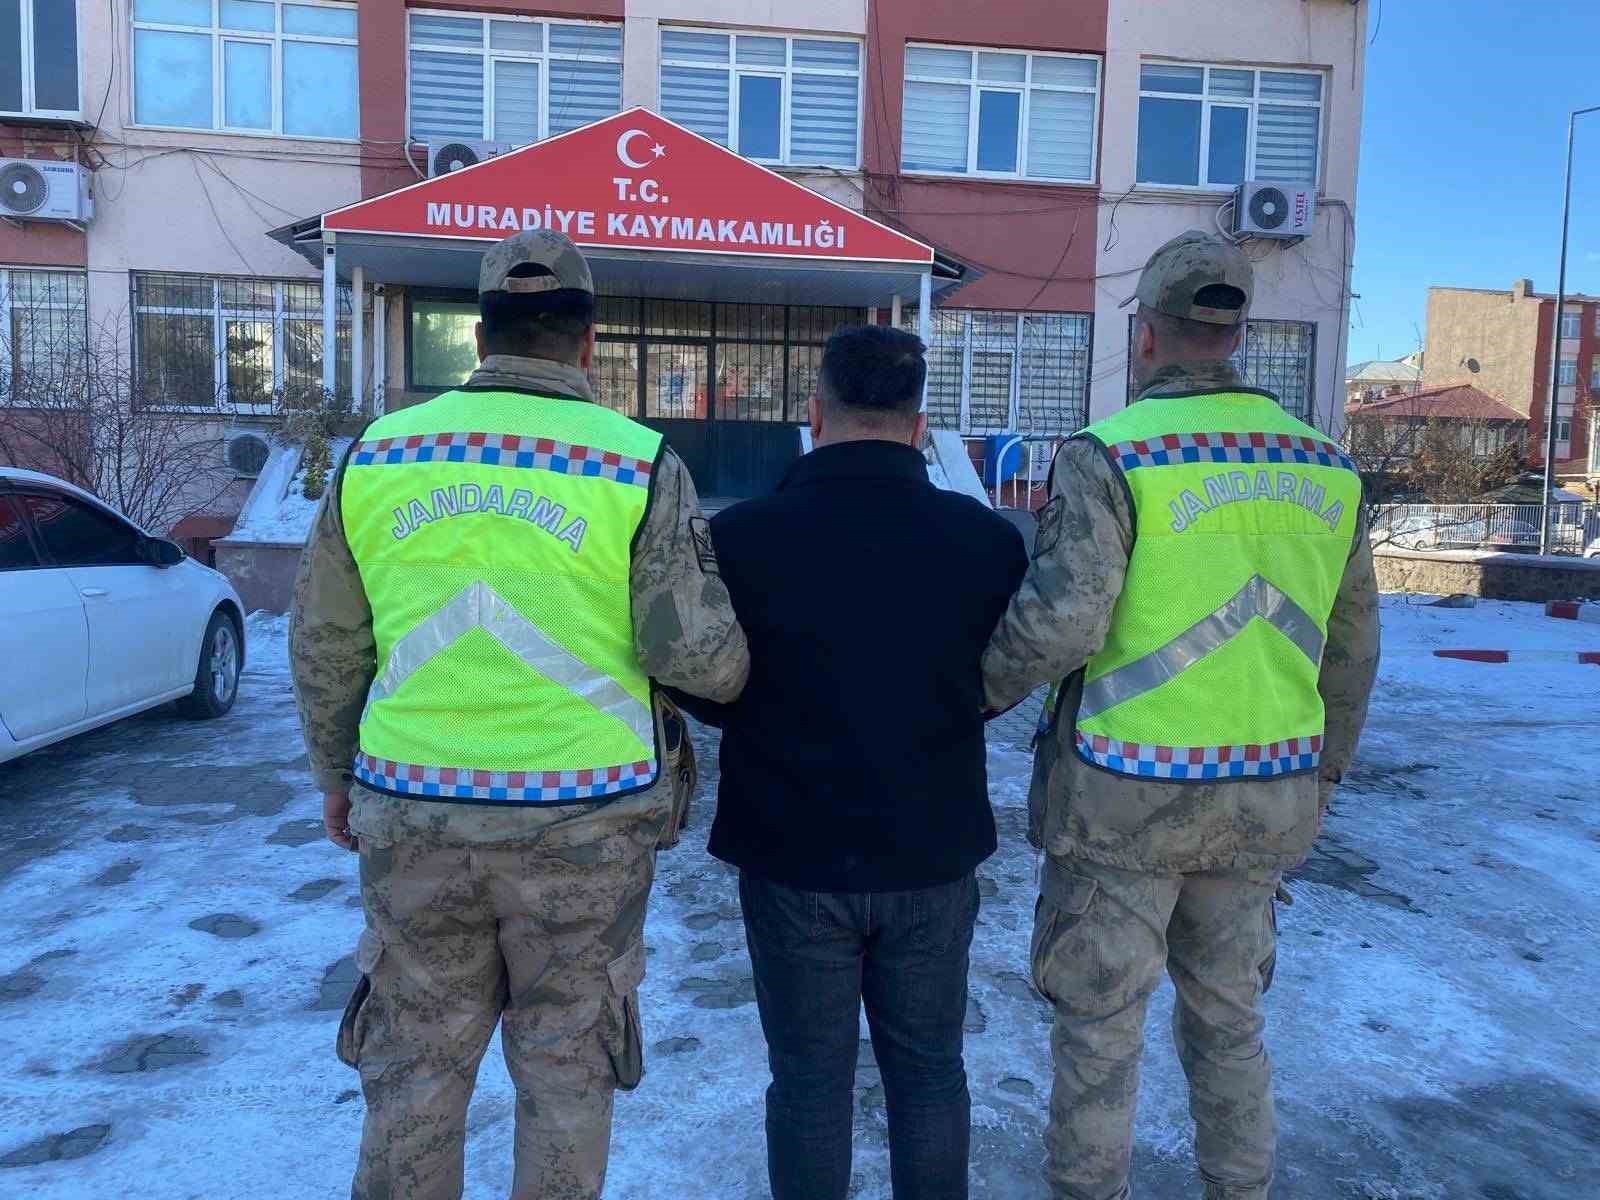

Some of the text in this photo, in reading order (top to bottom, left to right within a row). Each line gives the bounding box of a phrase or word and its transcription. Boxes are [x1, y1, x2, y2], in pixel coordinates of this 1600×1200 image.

[613, 177, 670, 203] T.C.
[1295, 192, 1304, 227] VESTEL
[426, 202, 845, 249] MURADİYE KAYMAKAMLIĞI
[392, 483, 588, 553] JANDARMA
[1168, 470, 1345, 533] JANDARMA
